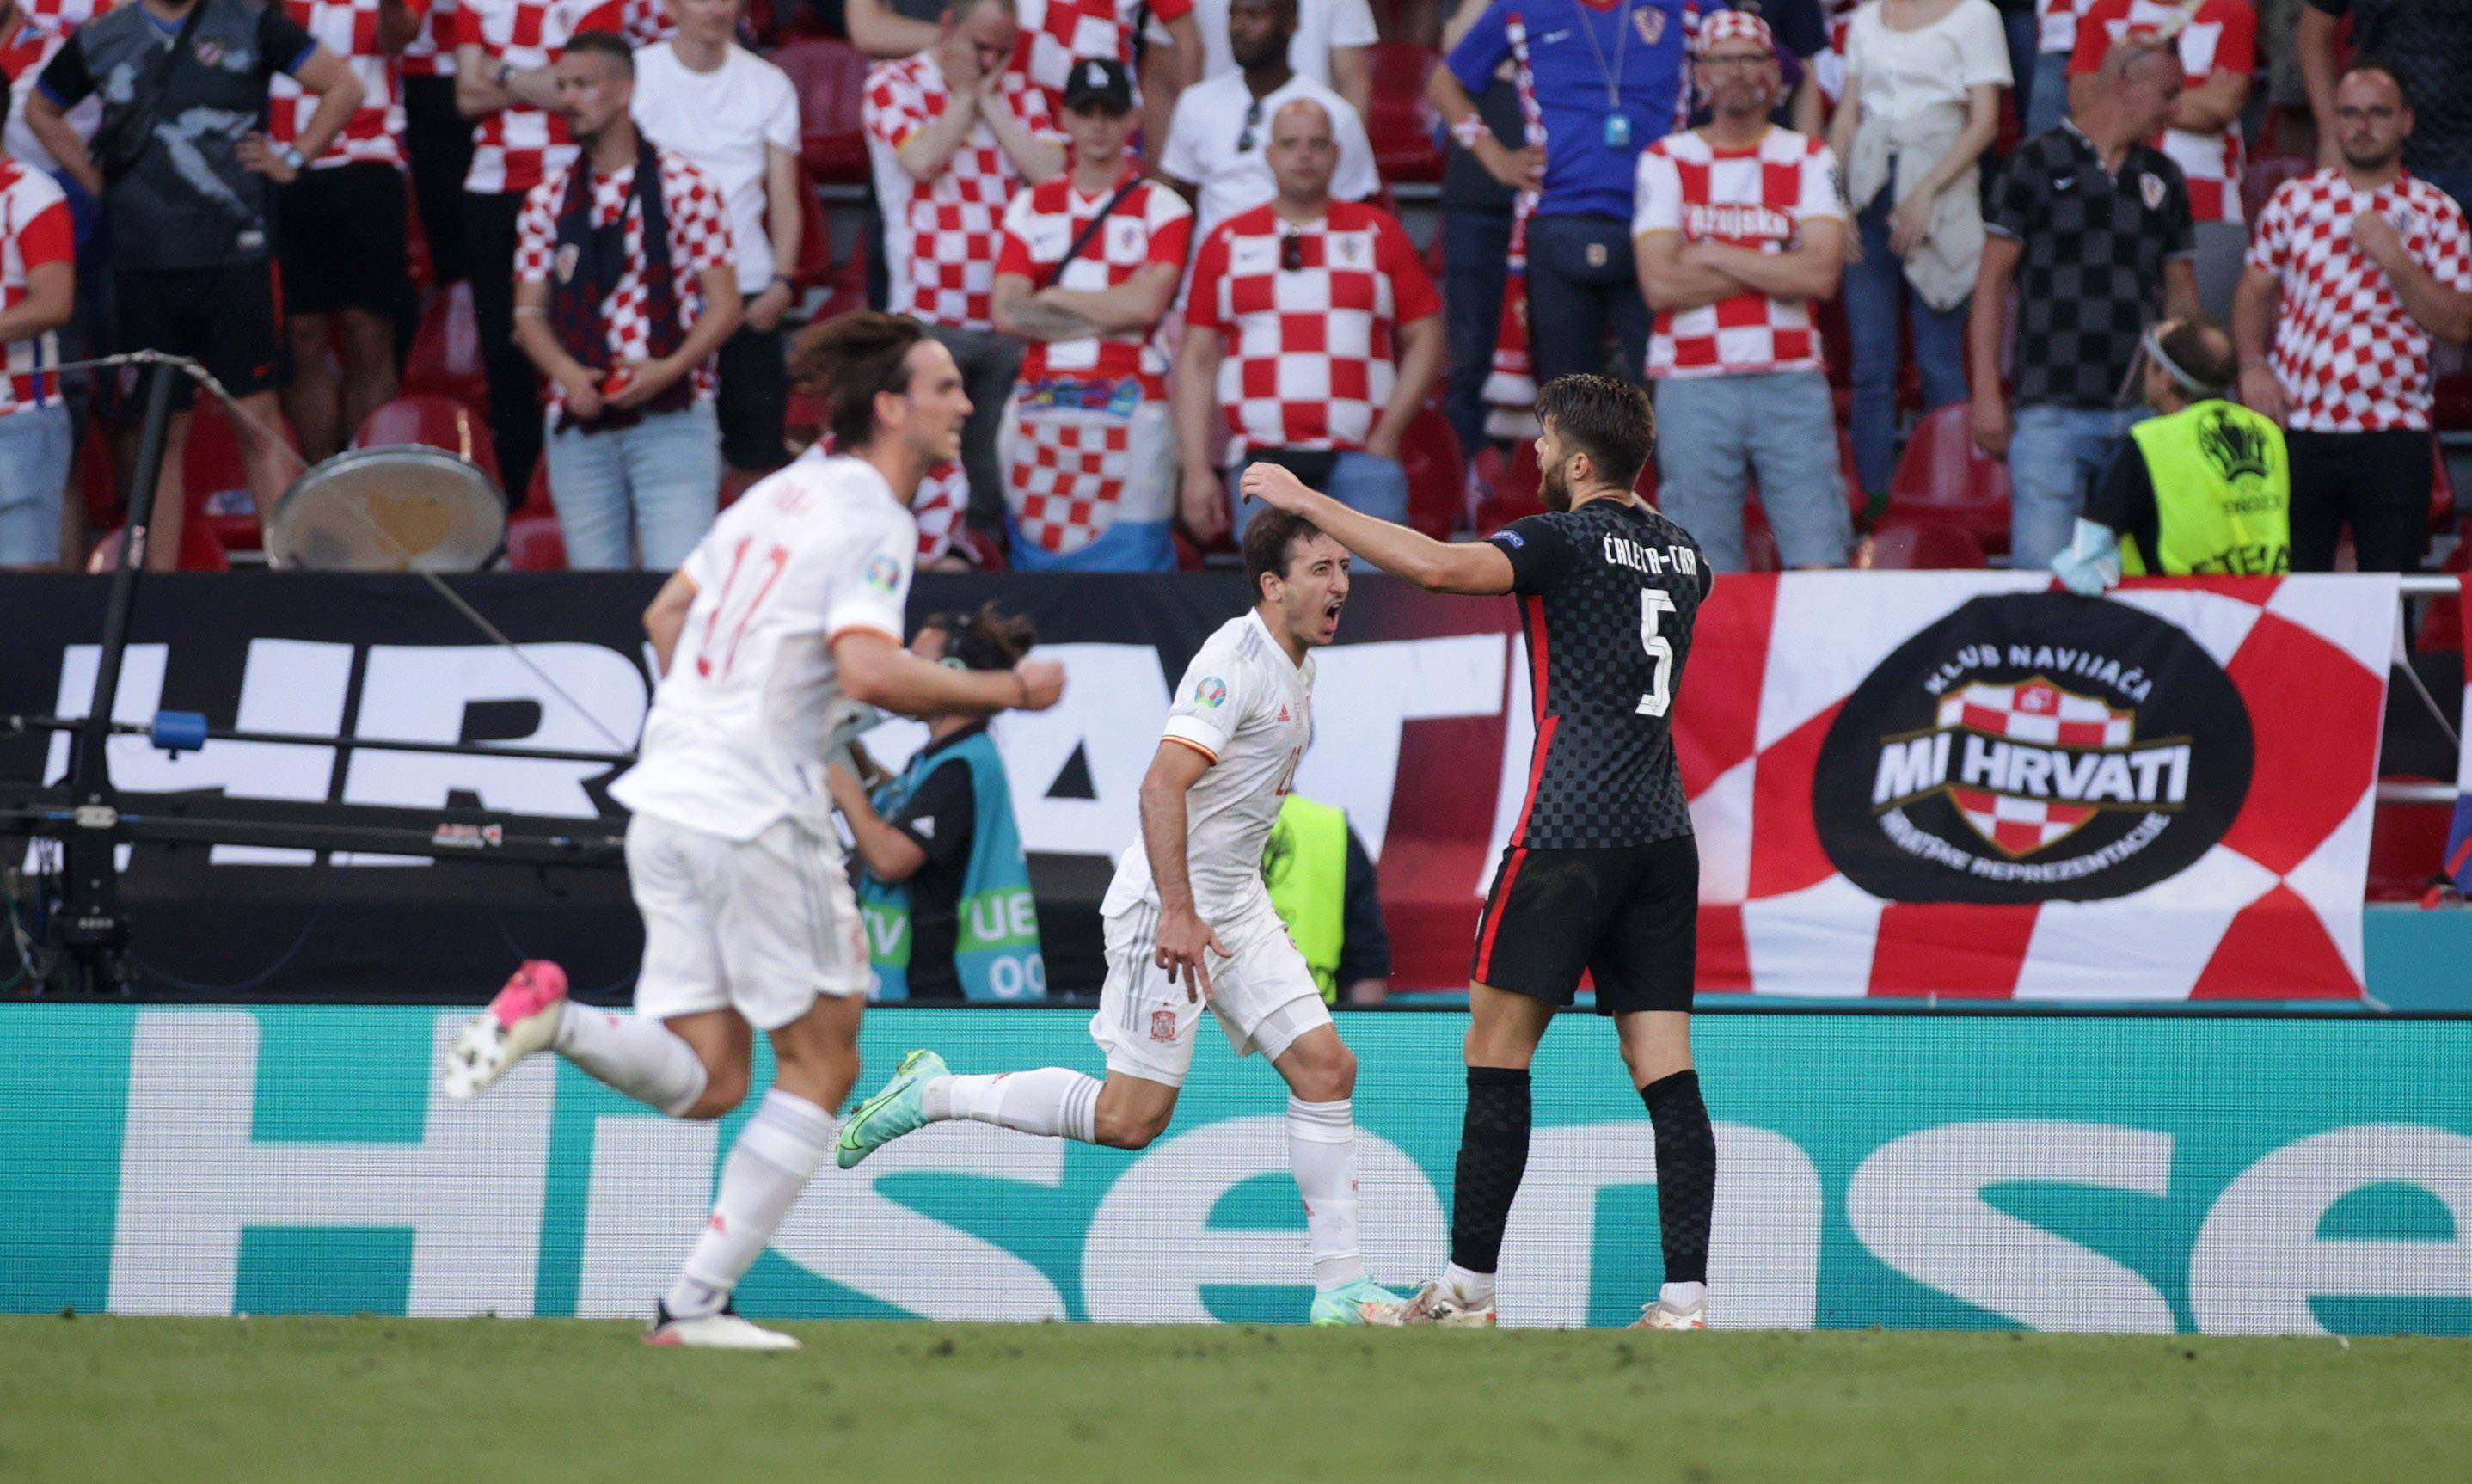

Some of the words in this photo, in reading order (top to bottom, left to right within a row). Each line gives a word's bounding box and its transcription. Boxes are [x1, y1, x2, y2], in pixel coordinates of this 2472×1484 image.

[1635, 588, 1677, 718] 5
[1924, 645, 2002, 695] KLUB
[1872, 733, 1953, 804] MI
[1960, 735, 2192, 804] HRVATI
[106, 1011, 2472, 1335] Hisense
